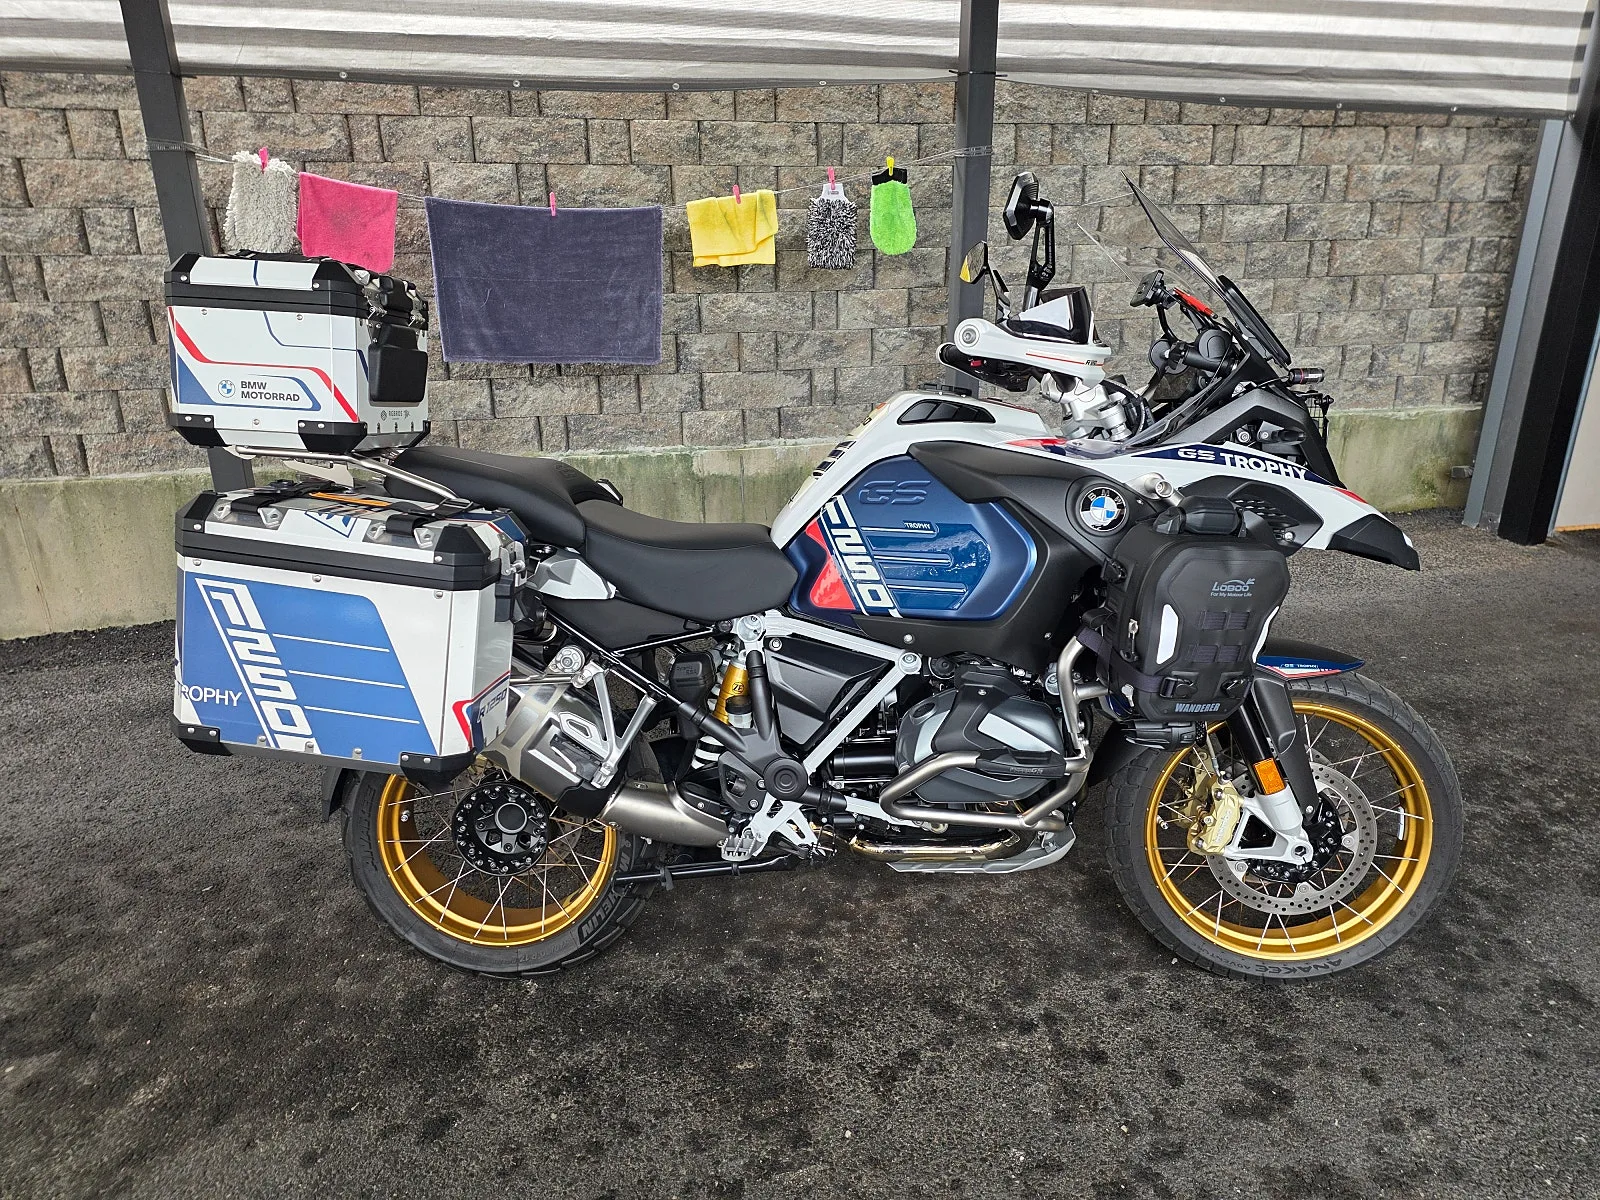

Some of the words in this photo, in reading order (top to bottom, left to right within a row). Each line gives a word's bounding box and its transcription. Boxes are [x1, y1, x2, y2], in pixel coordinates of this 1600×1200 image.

[240, 381, 267, 389] BMW
[241, 391, 300, 402] MOTORRAD
[1177, 448, 1216, 461] GS
[1219, 452, 1307, 481] TROPHY
[858, 480, 931, 505] GS
[1087, 489, 1123, 505] BMW
[904, 522, 931, 530] TROPHY
[1175, 702, 1221, 713] WANDERER
[1255, 958, 1343, 974] ANAKEE
